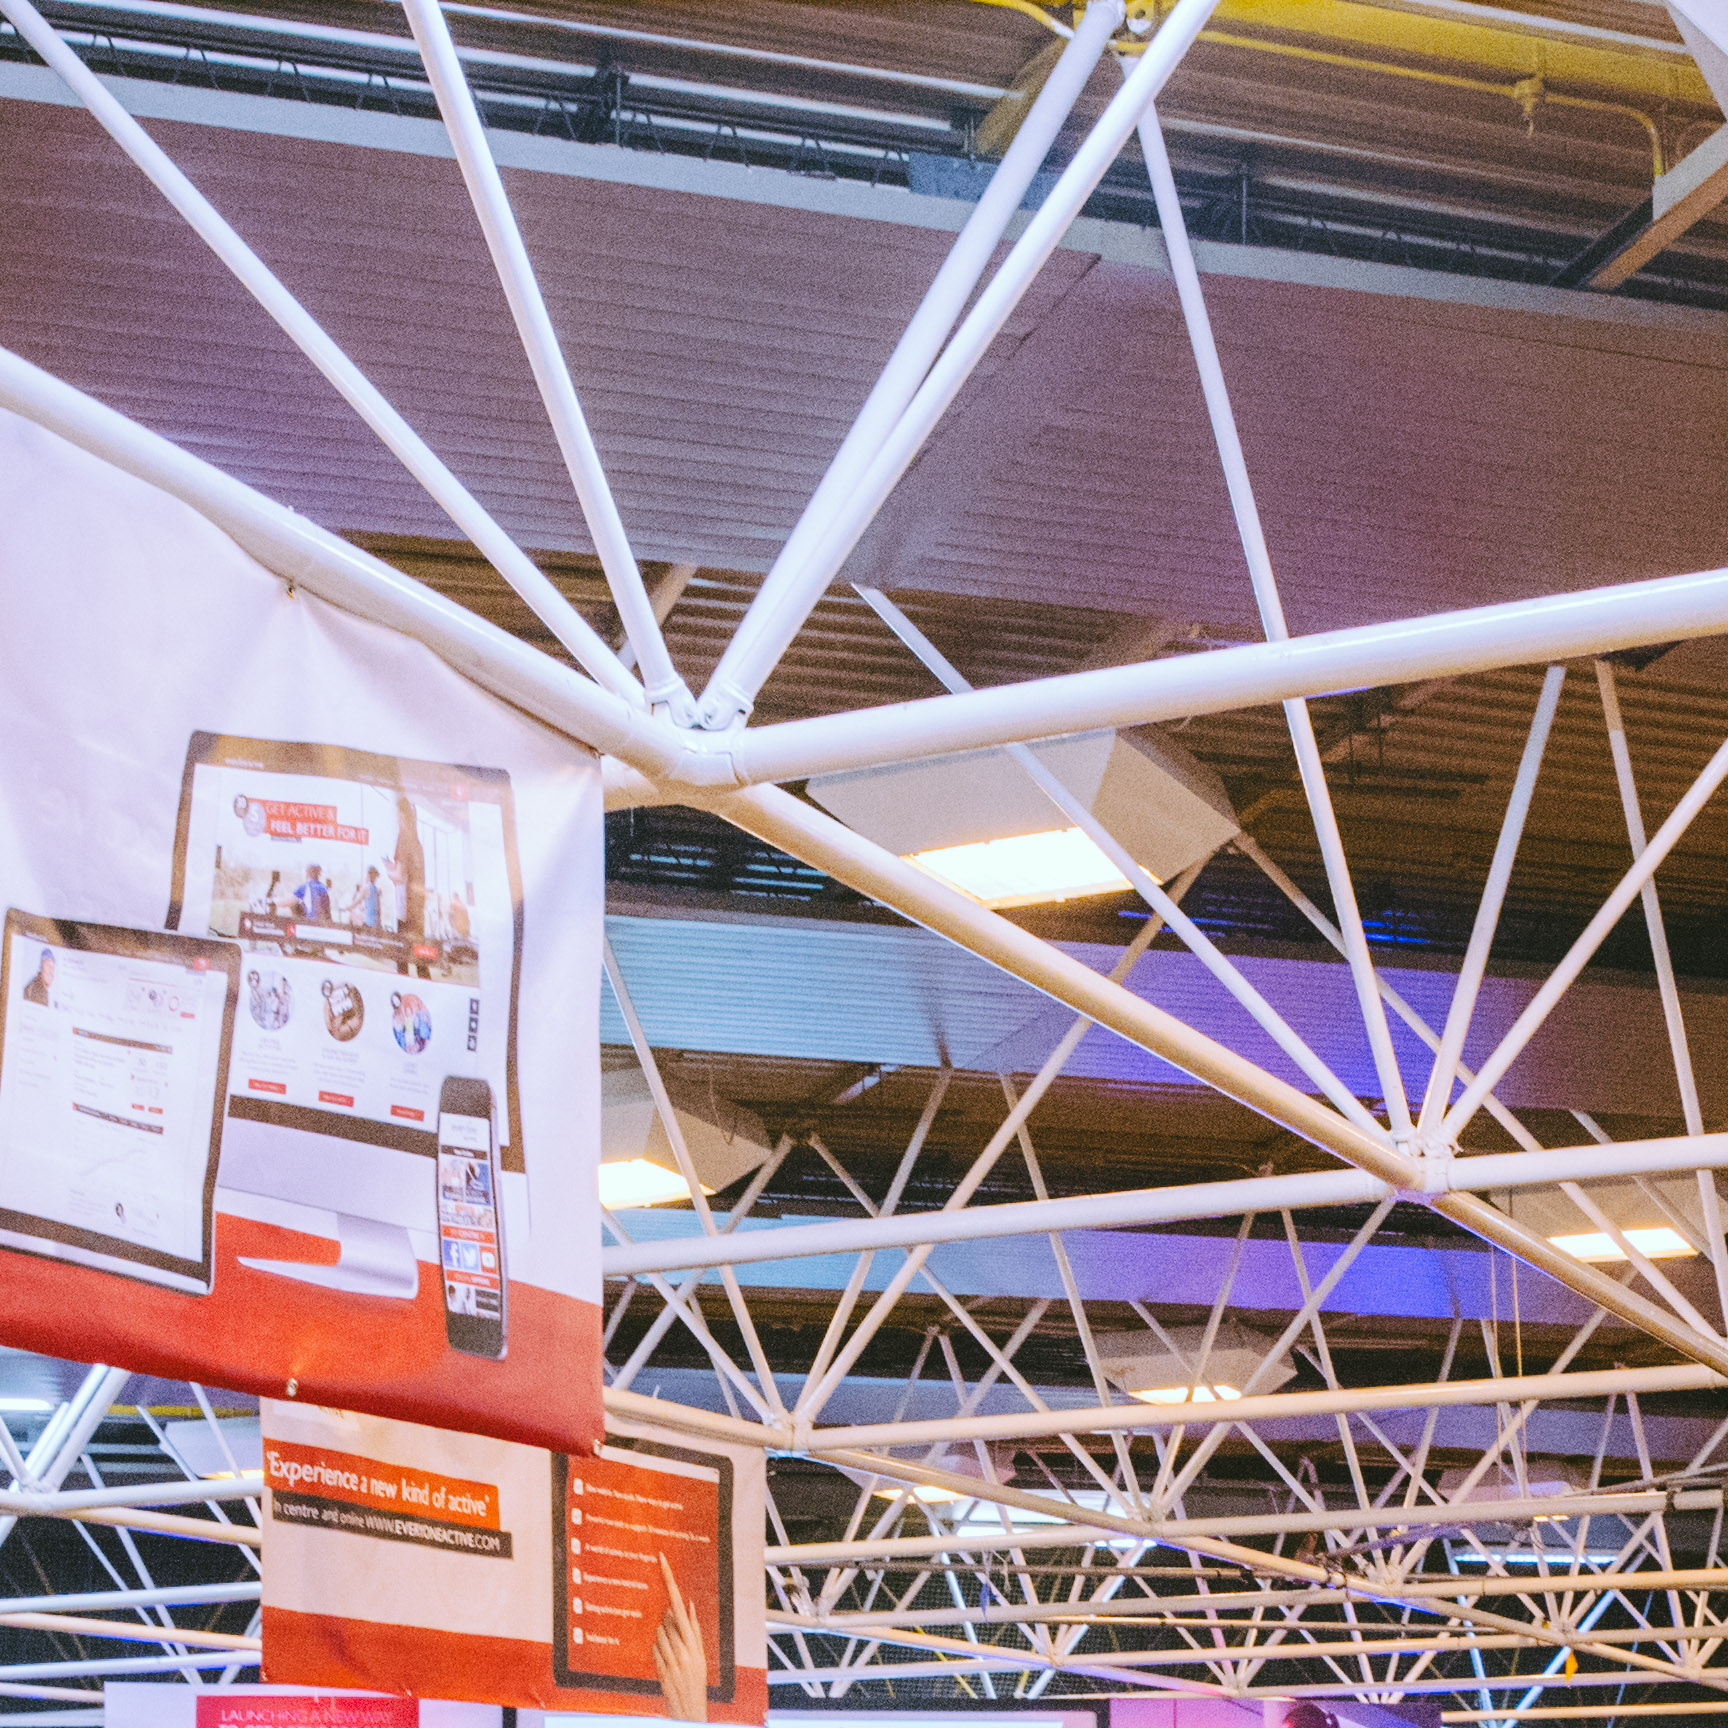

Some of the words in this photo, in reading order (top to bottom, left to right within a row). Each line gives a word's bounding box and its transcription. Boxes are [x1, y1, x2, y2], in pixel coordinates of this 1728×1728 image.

[360, 1476, 368, 1494] a
[370, 1478, 397, 1499] new
[401, 1478, 429, 1506] kind
[432, 1486, 446, 1509] of
[283, 1503, 319, 1519] centre
[221, 1709, 307, 1723] LAUNCHING
